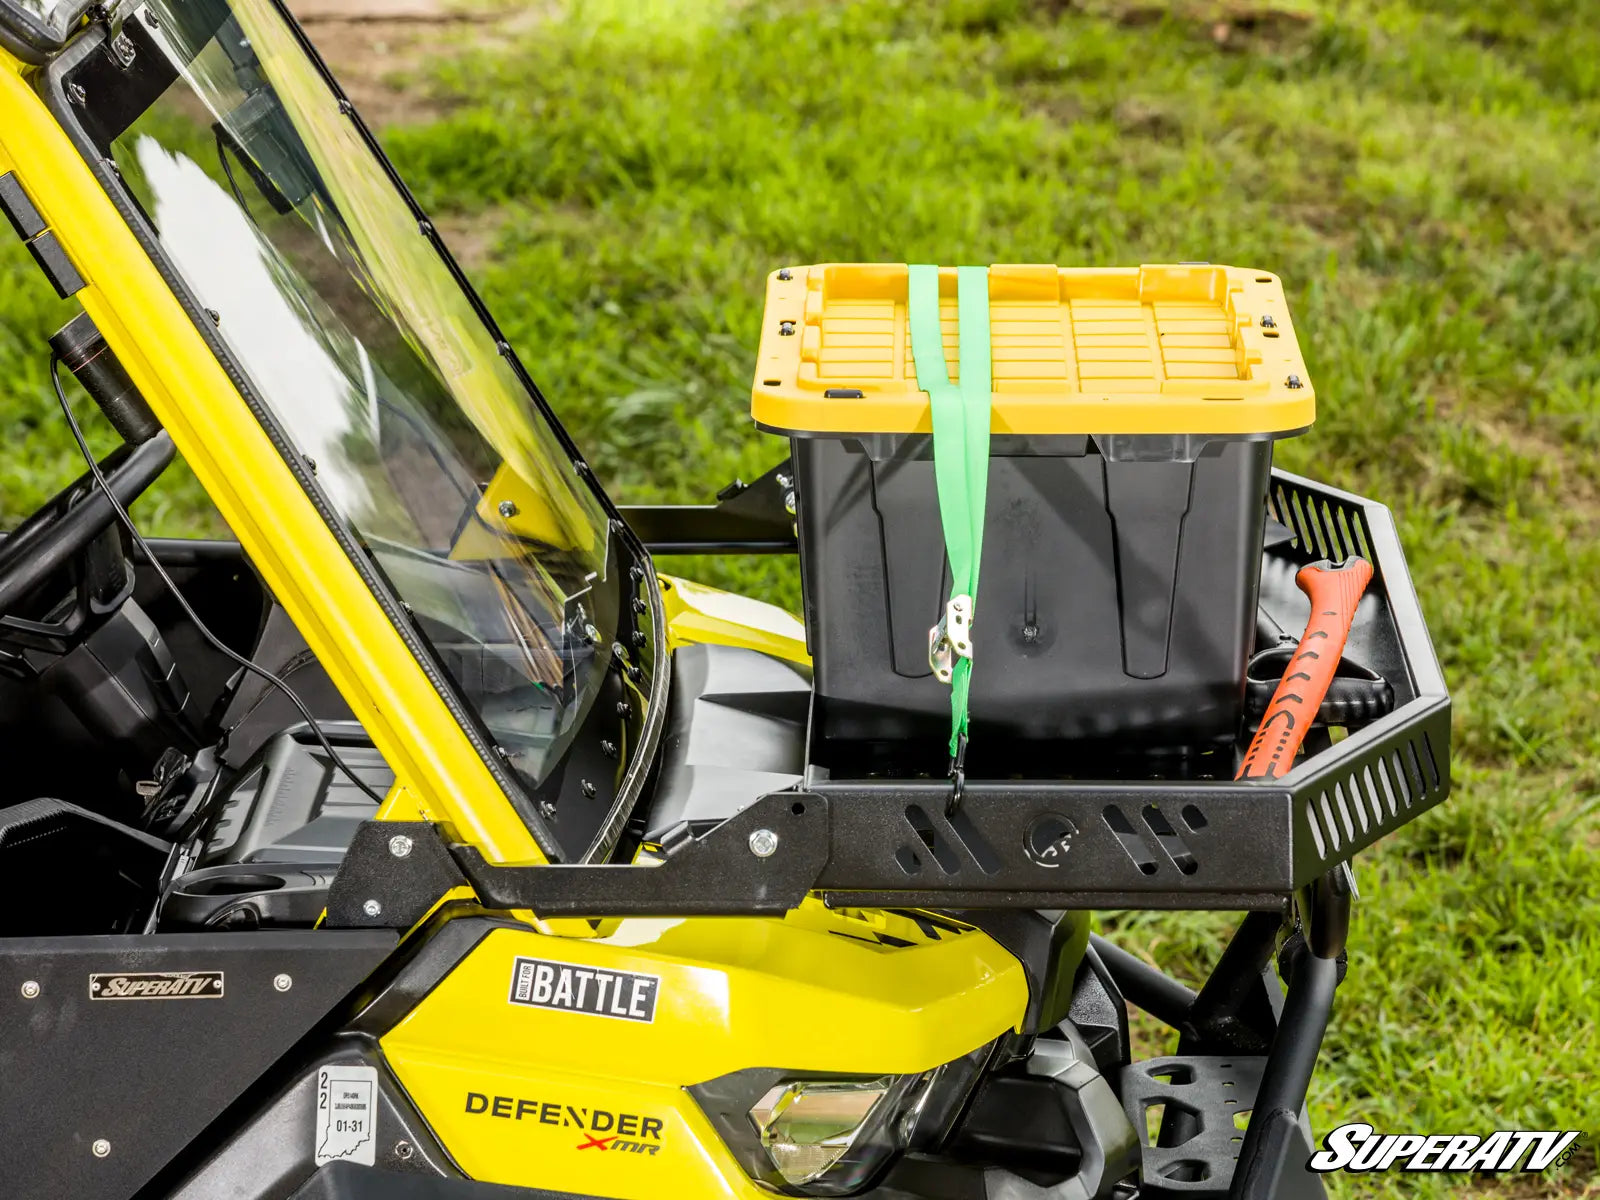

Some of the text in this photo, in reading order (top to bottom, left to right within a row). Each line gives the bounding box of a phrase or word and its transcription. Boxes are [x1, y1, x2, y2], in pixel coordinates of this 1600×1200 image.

[101, 977, 212, 997] SUPERATV
[518, 965, 531, 998] BUILT FOR
[531, 964, 655, 1017] BATTLE
[336, 1119, 362, 1132] 01-31
[465, 1092, 663, 1139] DEFENDER
